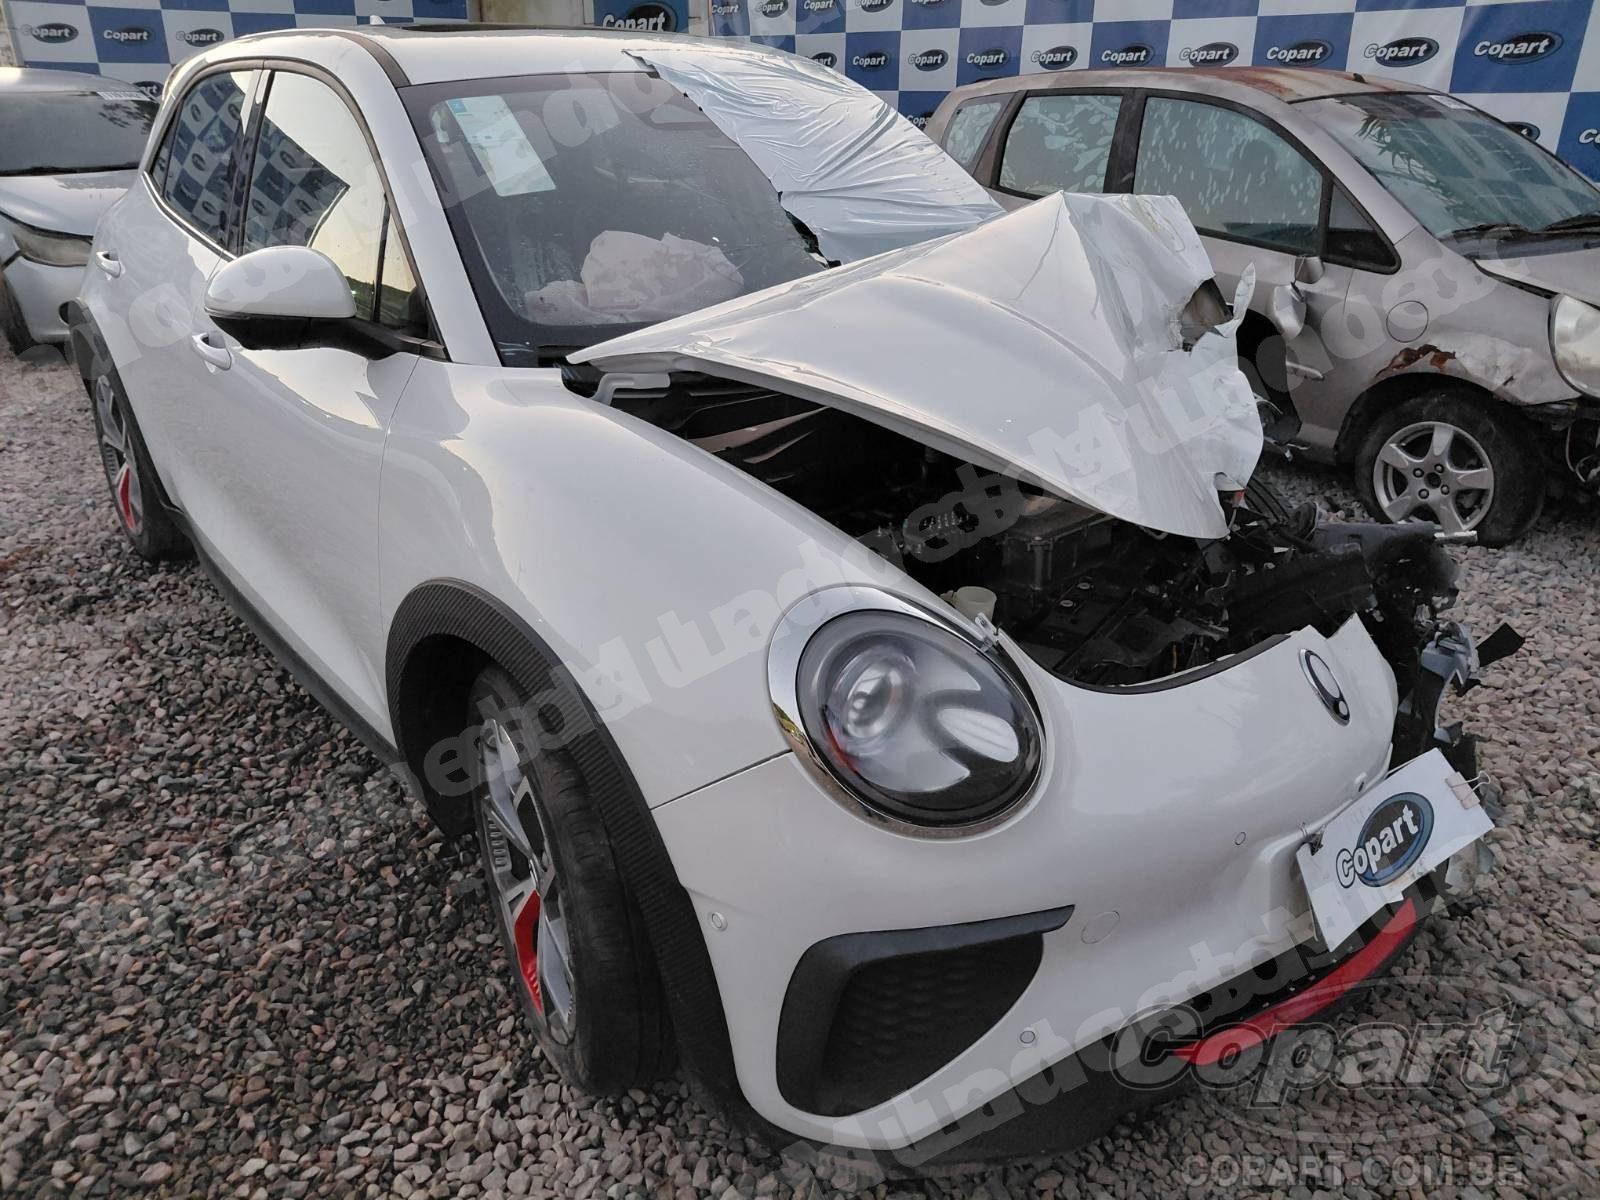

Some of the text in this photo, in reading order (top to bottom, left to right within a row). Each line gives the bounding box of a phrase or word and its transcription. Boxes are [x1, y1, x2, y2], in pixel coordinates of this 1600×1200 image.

[711, 4, 739, 15] Copart
[804, 0, 834, 11] Copart
[21, 24, 70, 38] Copart
[103, 29, 149, 42] Copart
[176, 30, 217, 42] Copart
[1266, 46, 1323, 62] Copart
[1364, 42, 1429, 60] Copart
[1474, 38, 1550, 58] Copart
[908, 54, 943, 66] Copart
[966, 52, 1004, 65] Copart
[1031, 51, 1073, 62] Copart
[1101, 49, 1147, 63] Copart
[1179, 47, 1230, 63] Copart
[853, 56, 886, 68] Copart
[1336, 804, 1420, 889] Copart
